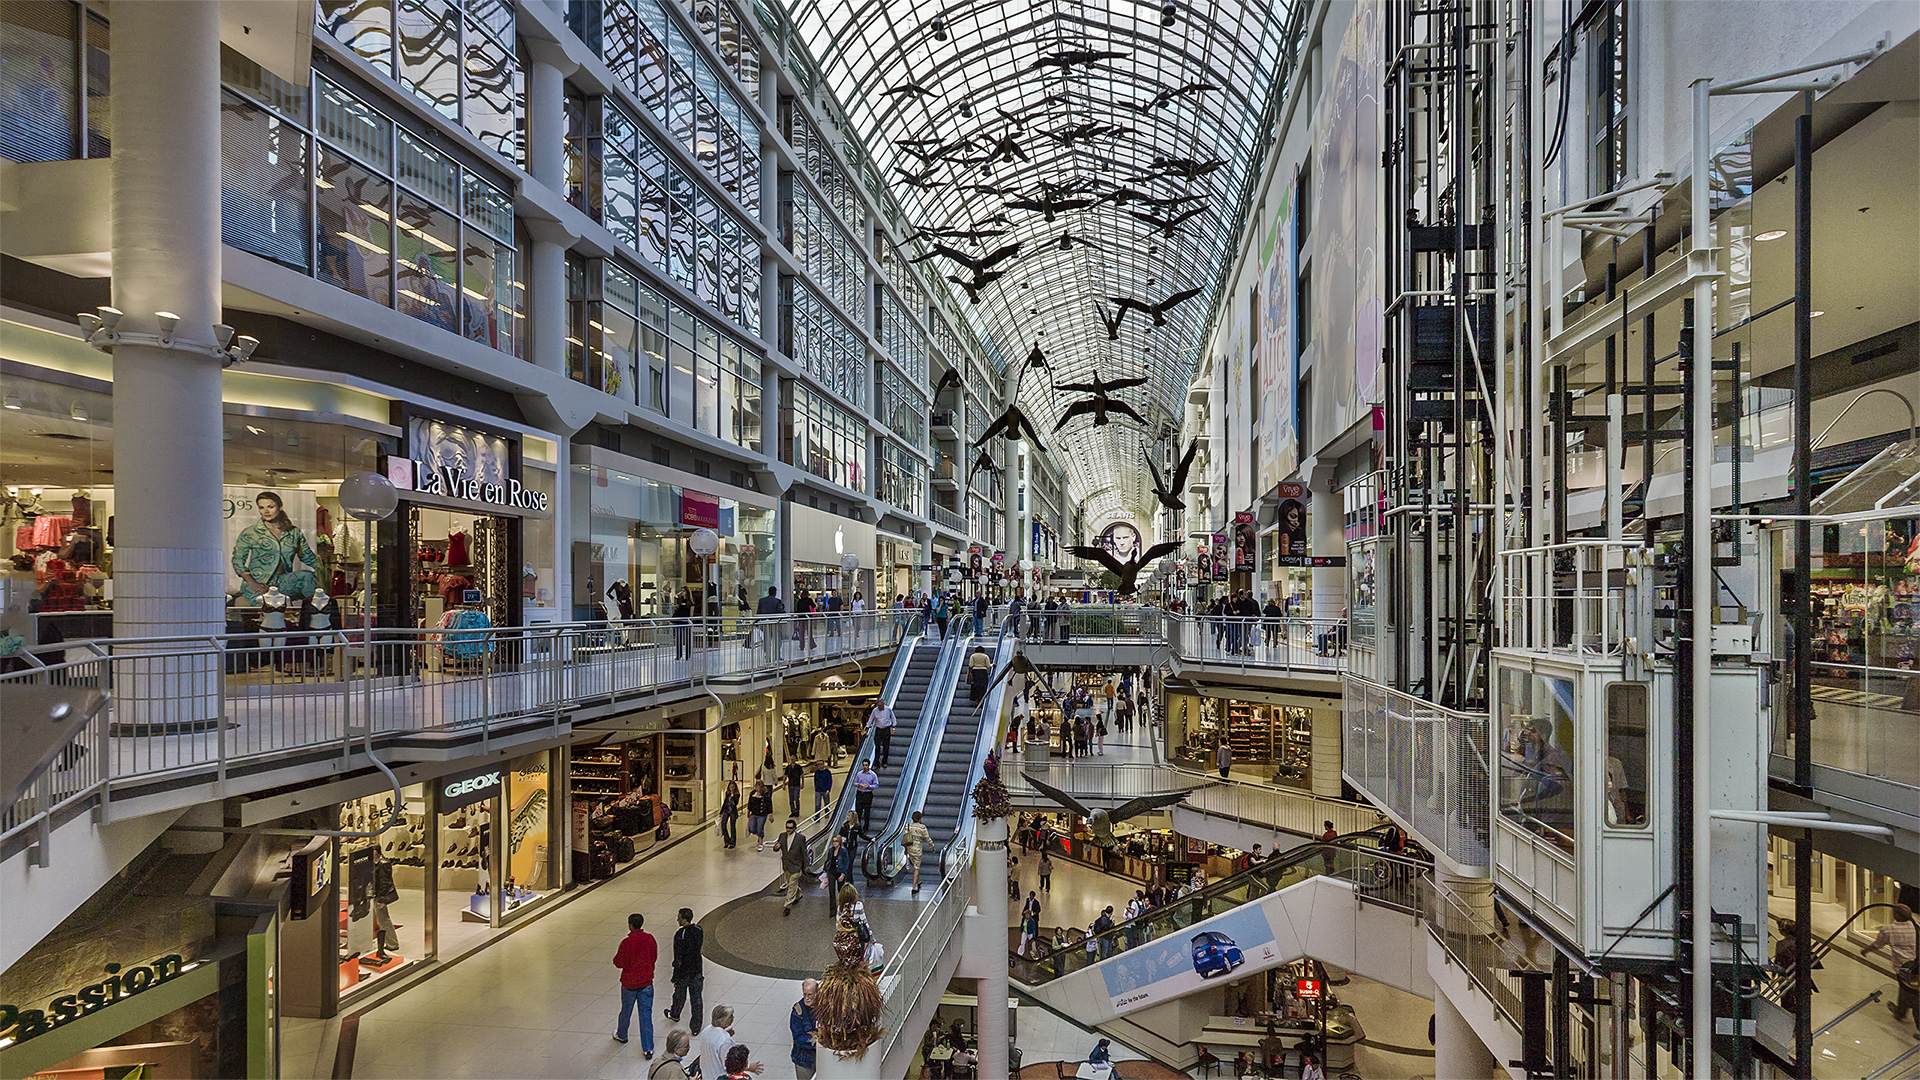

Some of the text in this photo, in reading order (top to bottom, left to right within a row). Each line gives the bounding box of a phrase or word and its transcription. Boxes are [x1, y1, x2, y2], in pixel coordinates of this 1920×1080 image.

[414, 460, 548, 512] La Vie en Rose
[444, 771, 501, 799] GEOX
